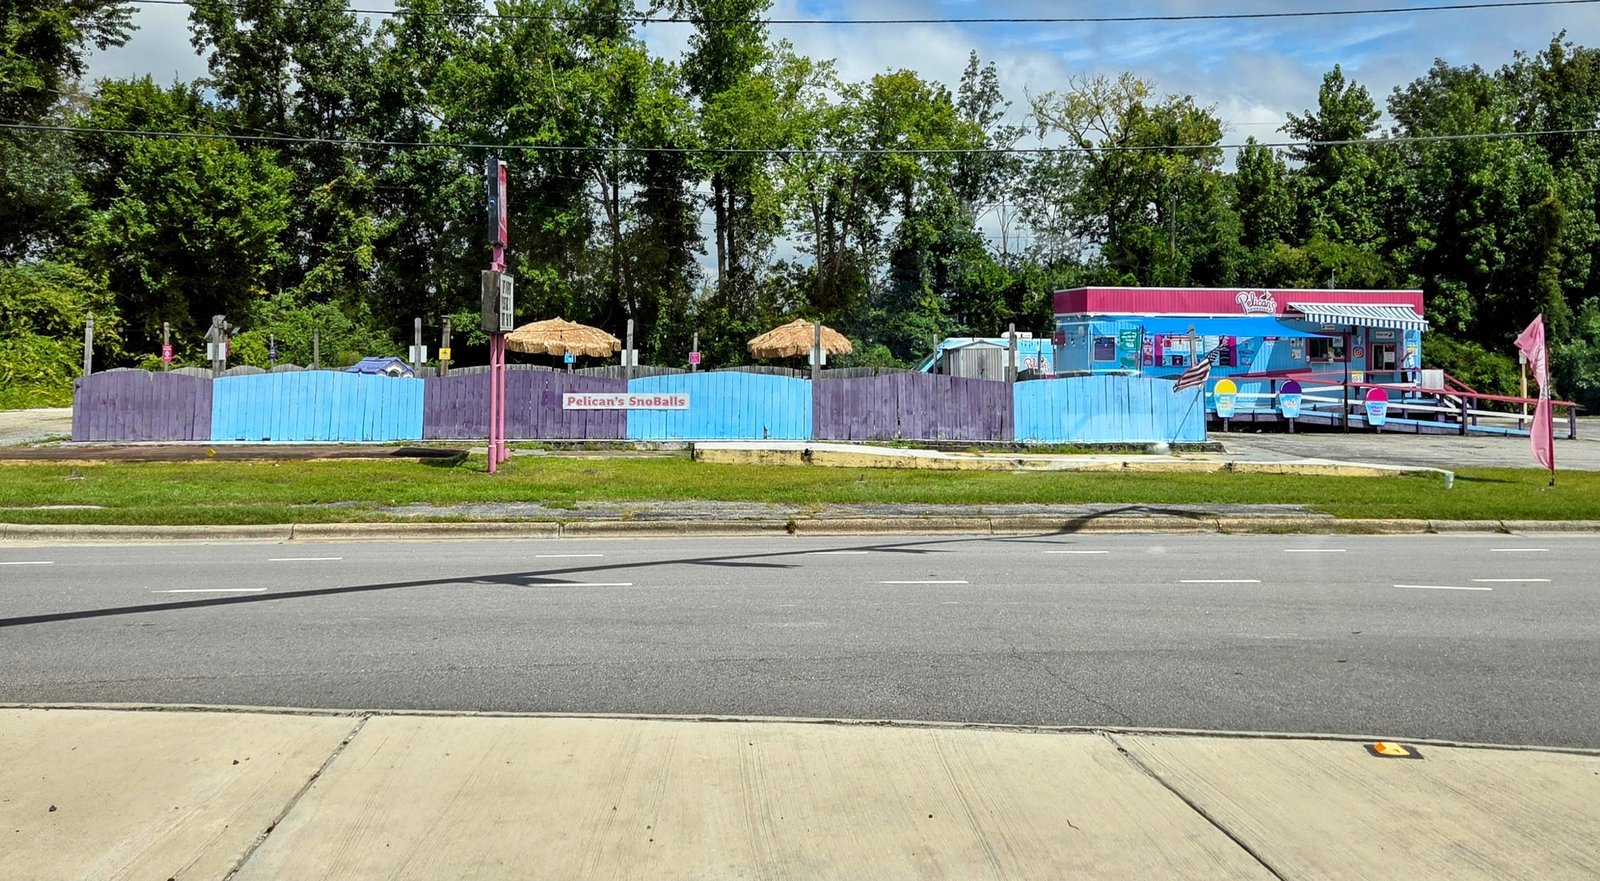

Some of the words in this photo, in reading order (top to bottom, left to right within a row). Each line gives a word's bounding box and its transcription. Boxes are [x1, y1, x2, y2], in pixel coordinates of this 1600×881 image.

[1236, 292, 1277, 315] Pelican's
[567, 396, 625, 407] Pelican's
[628, 396, 686, 407] SnoBalls
